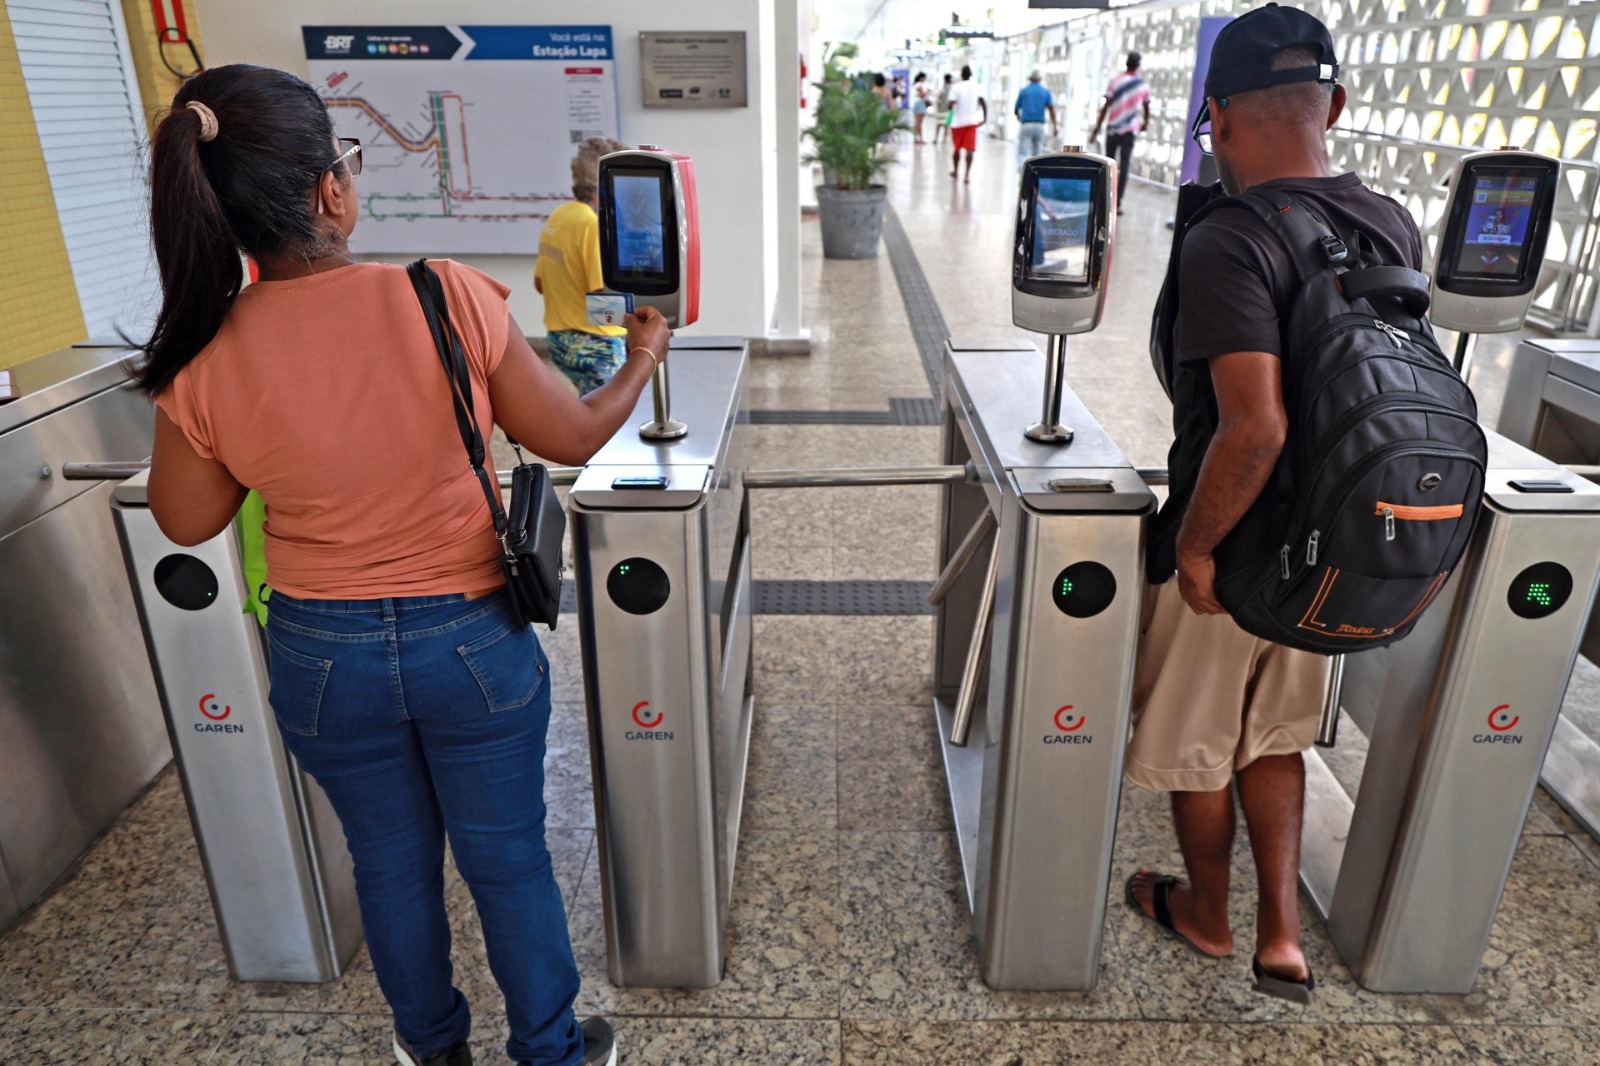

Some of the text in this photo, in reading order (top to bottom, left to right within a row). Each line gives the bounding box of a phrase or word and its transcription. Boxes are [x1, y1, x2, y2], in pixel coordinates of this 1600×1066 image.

[549, 32, 571, 42] Você
[573, 32, 591, 42] está
[324, 35, 354, 50] BRT
[533, 45, 607, 58] Estação Lapa
[1043, 229, 1078, 237] LIBERADO
[194, 723, 244, 733] GAREN
[625, 731, 674, 740] GAREN
[1043, 735, 1093, 744] GAREN
